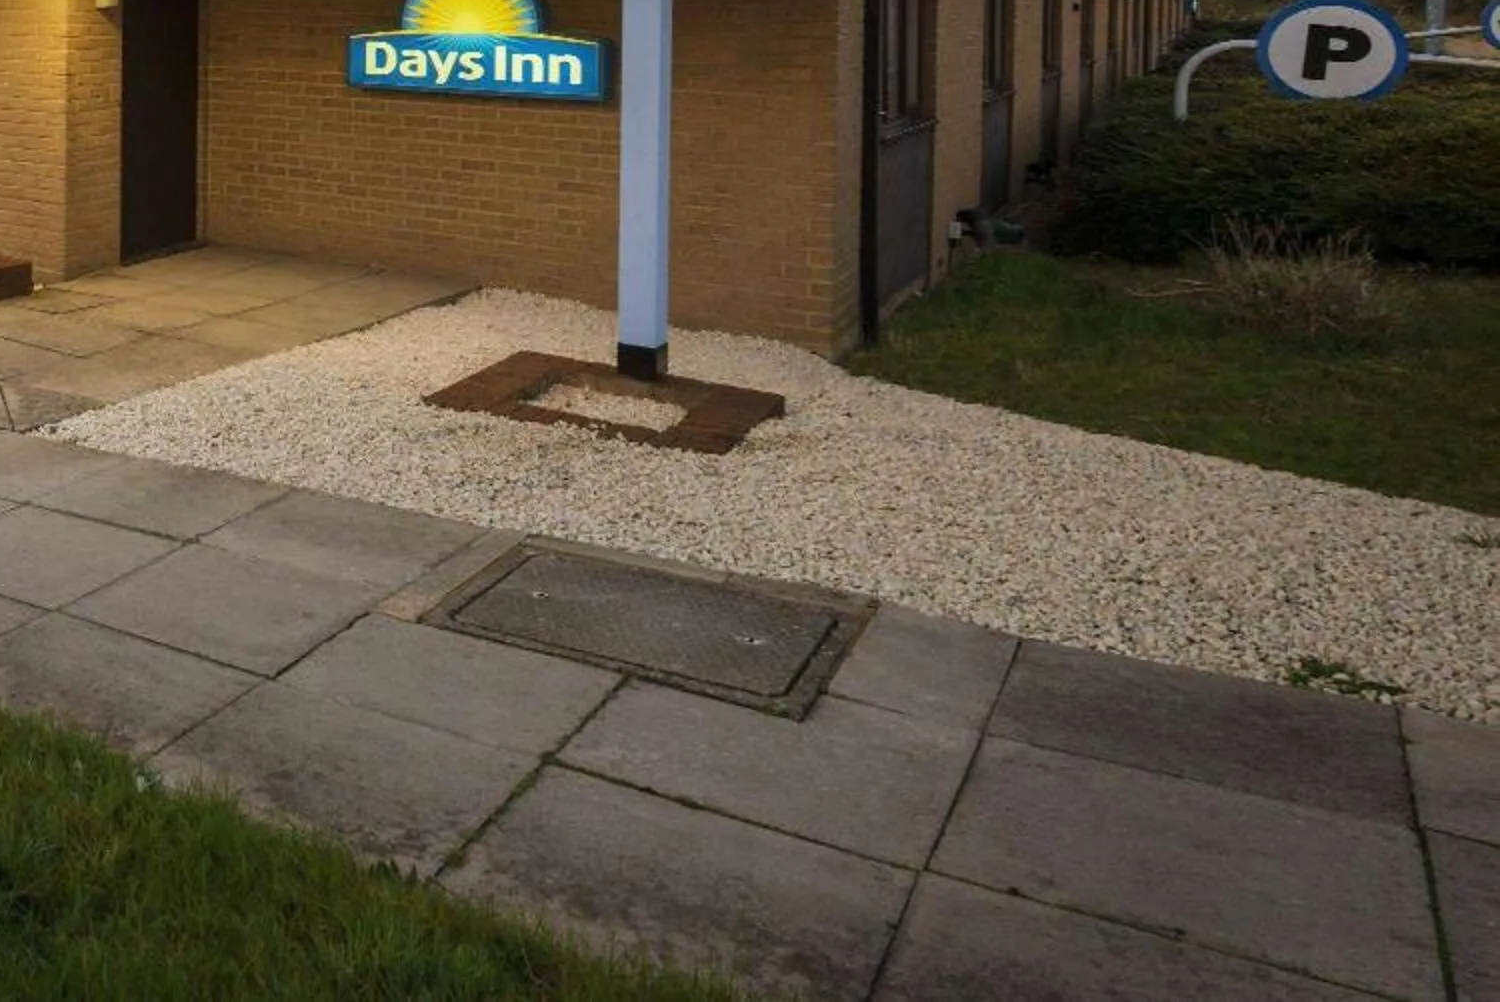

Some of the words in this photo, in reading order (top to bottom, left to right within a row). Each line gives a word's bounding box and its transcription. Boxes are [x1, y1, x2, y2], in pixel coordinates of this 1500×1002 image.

[364, 41, 485, 85] Days
[493, 45, 582, 85] Inn
[1302, 24, 1372, 81] P
